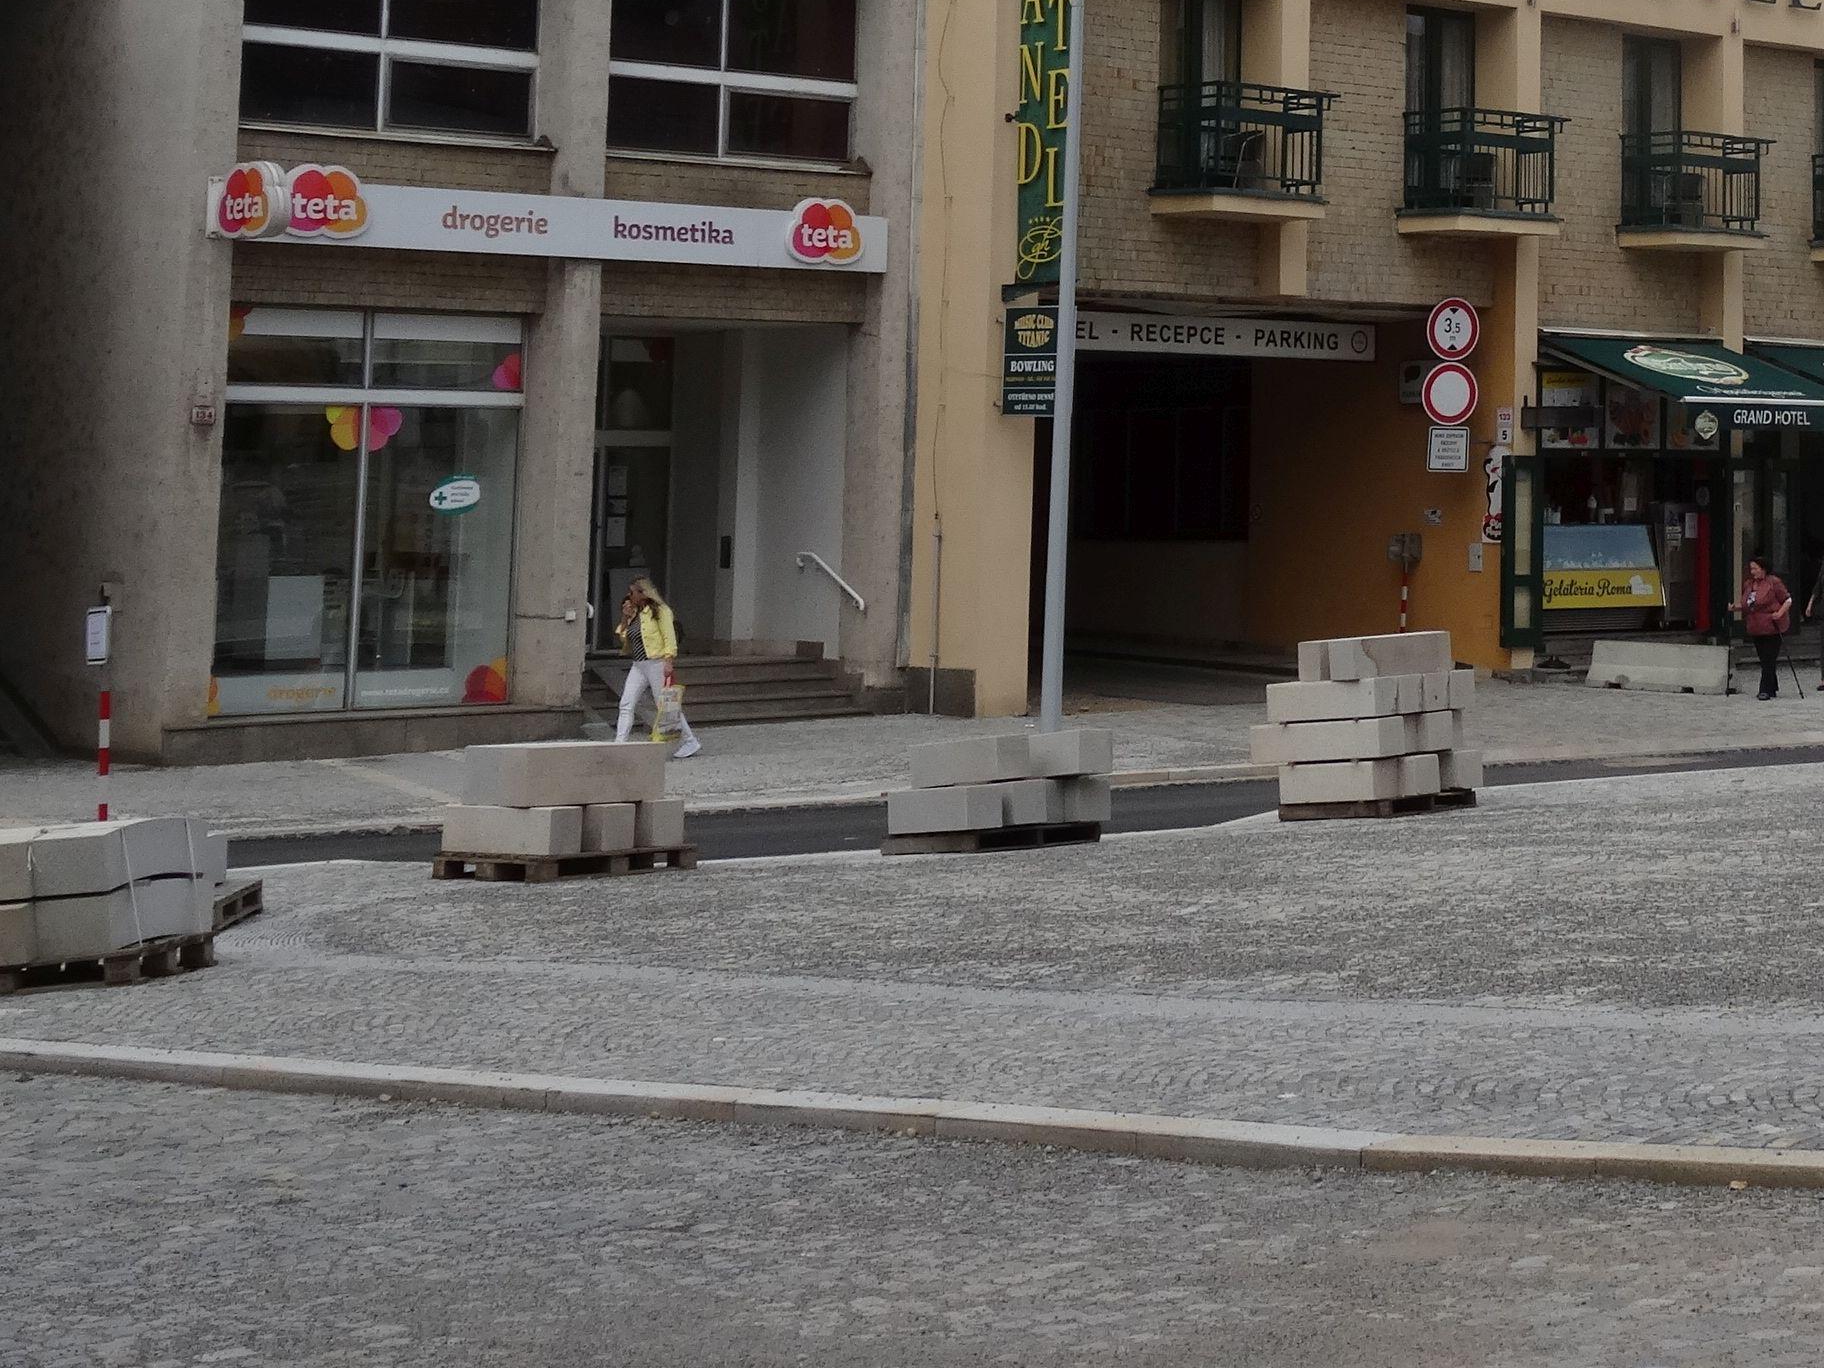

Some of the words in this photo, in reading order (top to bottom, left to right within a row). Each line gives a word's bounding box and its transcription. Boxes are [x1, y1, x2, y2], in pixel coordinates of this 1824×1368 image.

[225, 193, 264, 220] teta
[293, 192, 357, 220] teta
[442, 206, 548, 238] drogerie
[613, 216, 734, 245] kosmetika
[801, 223, 853, 249] teta
[1017, 330, 1050, 348] TITANIC
[1130, 323, 1225, 345] RECEPCE
[1254, 328, 1340, 350] PARKING
[1010, 361, 1054, 372] BOWLING
[1733, 409, 1772, 425] GRAND
[1774, 410, 1811, 426] HOTEL
[1501, 430, 1508, 441] 5
[1543, 579, 1596, 604] Gelateria
[1596, 578, 1632, 598] Roma
